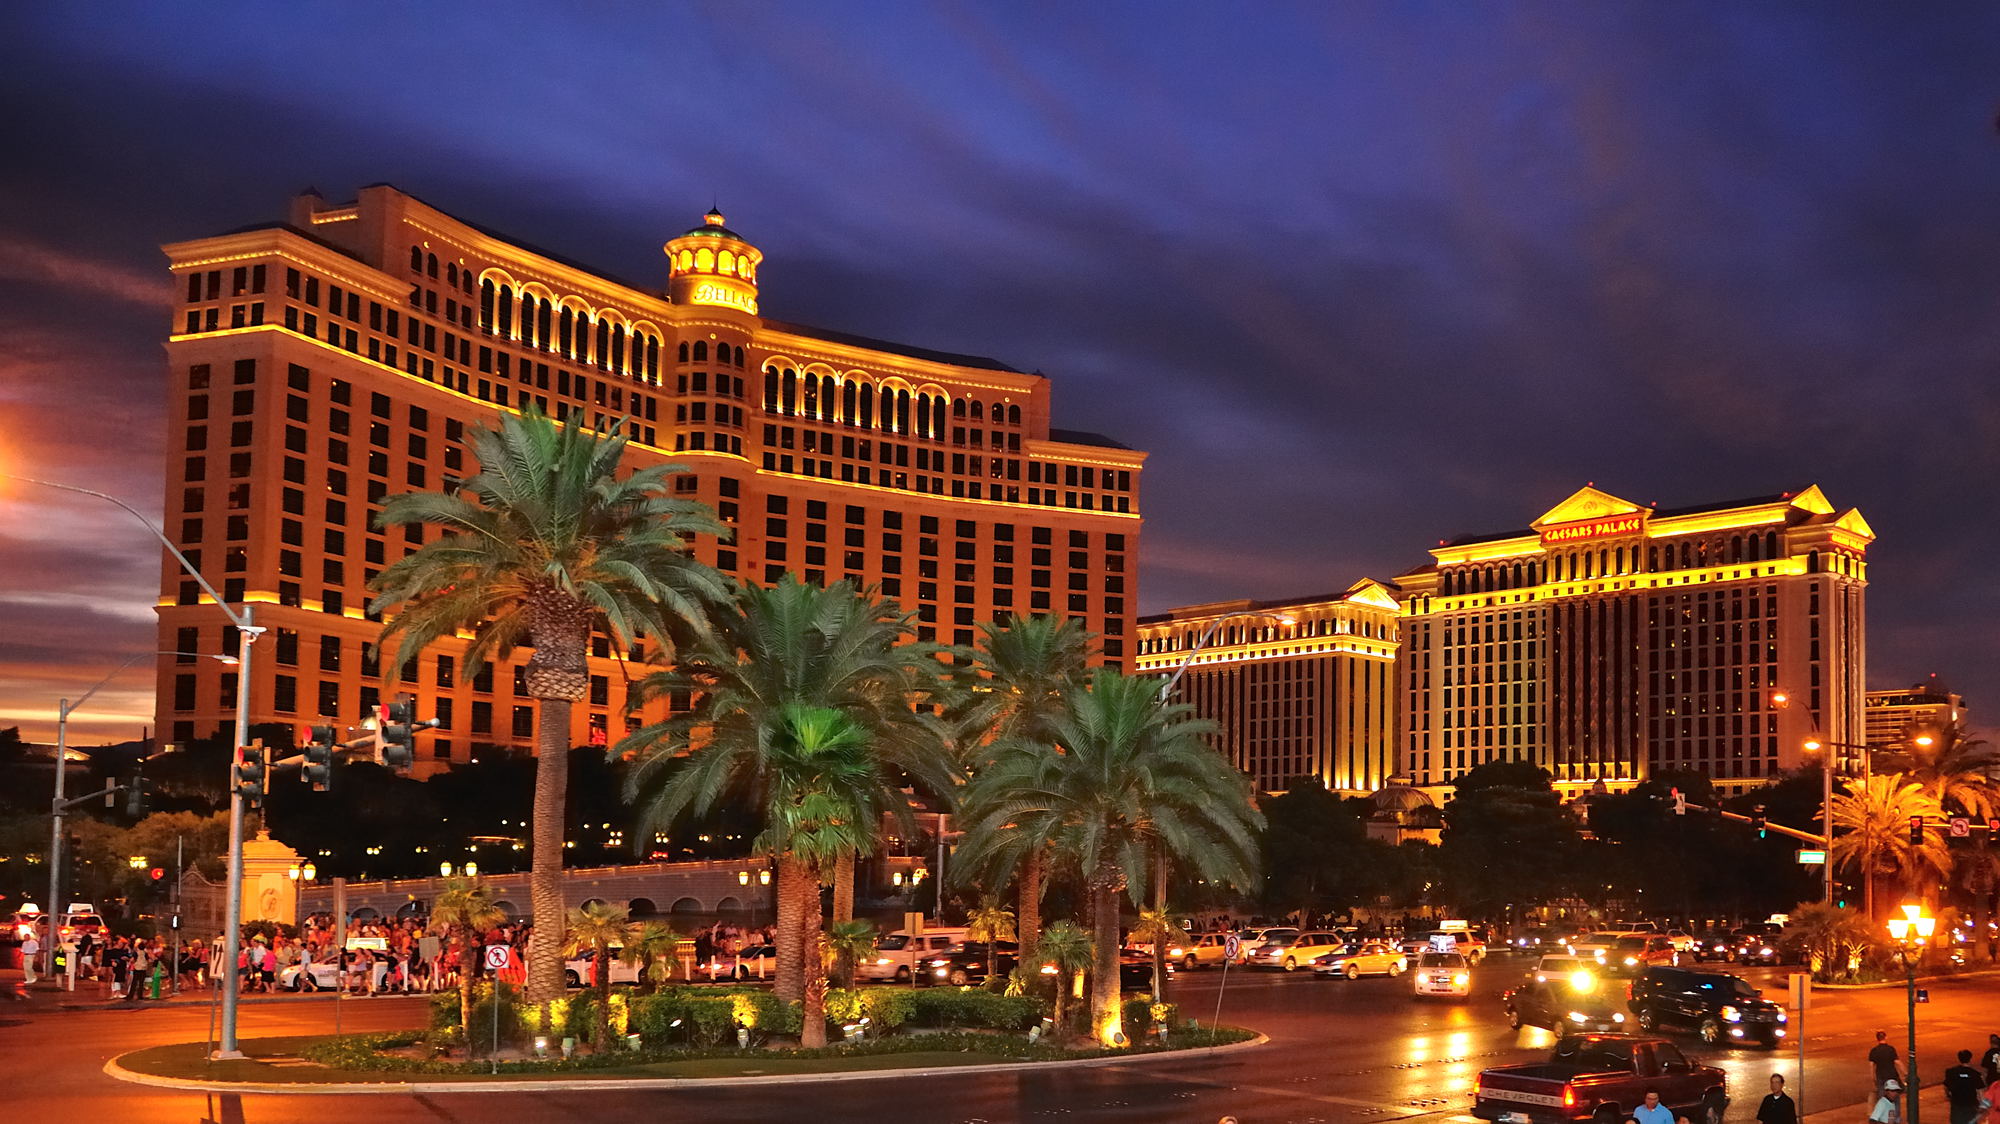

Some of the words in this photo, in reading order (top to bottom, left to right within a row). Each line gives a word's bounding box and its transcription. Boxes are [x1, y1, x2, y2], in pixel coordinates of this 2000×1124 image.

[1545, 525, 1593, 541] CAESARS
[1595, 519, 1640, 535] PALACE
[1487, 1089, 1556, 1105] CHEVROLET
